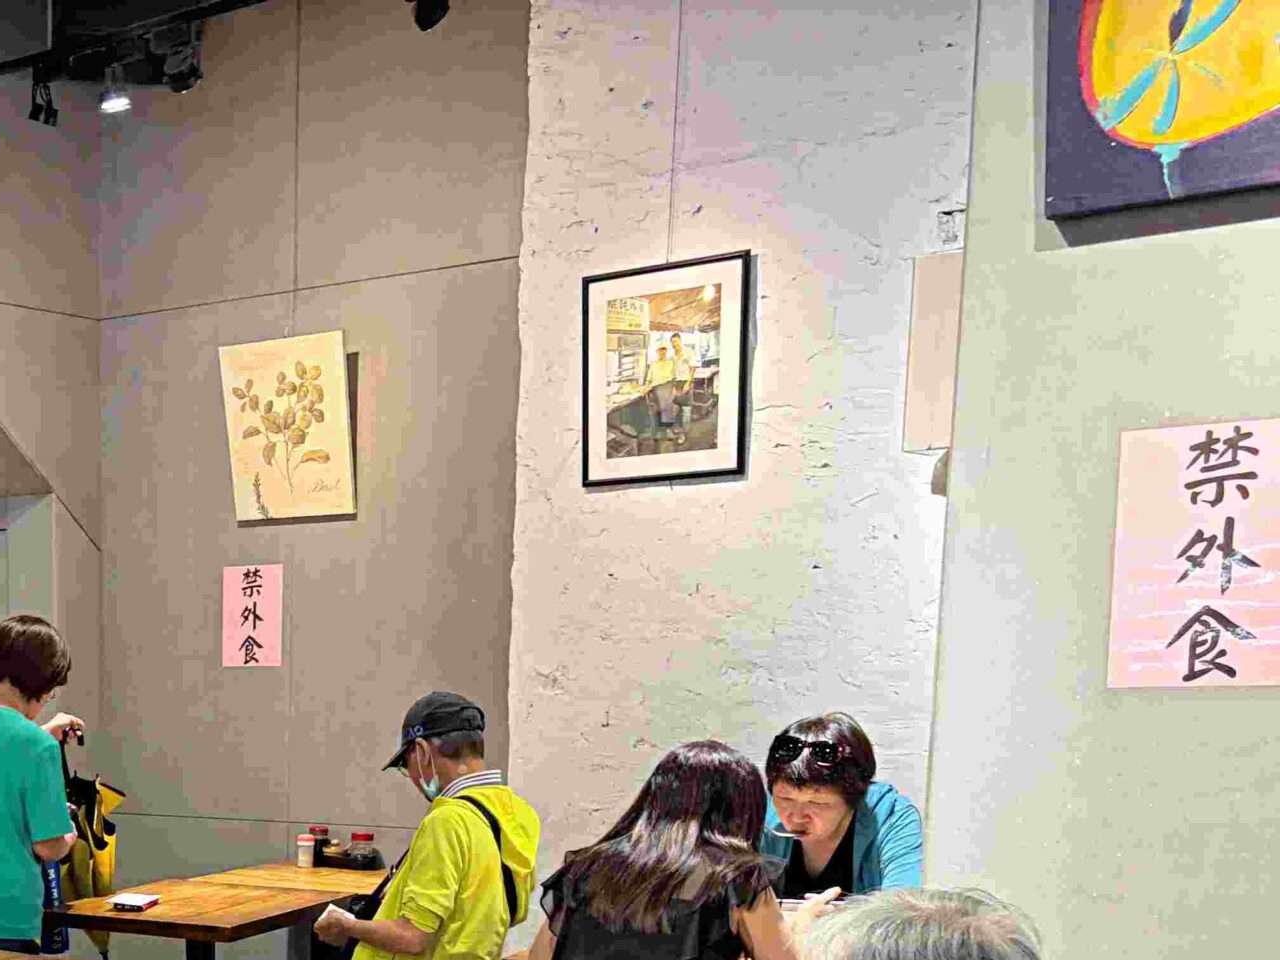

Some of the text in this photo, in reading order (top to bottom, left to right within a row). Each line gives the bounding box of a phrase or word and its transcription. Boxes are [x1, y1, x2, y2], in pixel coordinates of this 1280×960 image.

[238, 567, 265, 665] 禁外食
[1165, 425, 1262, 683] 禁外食
